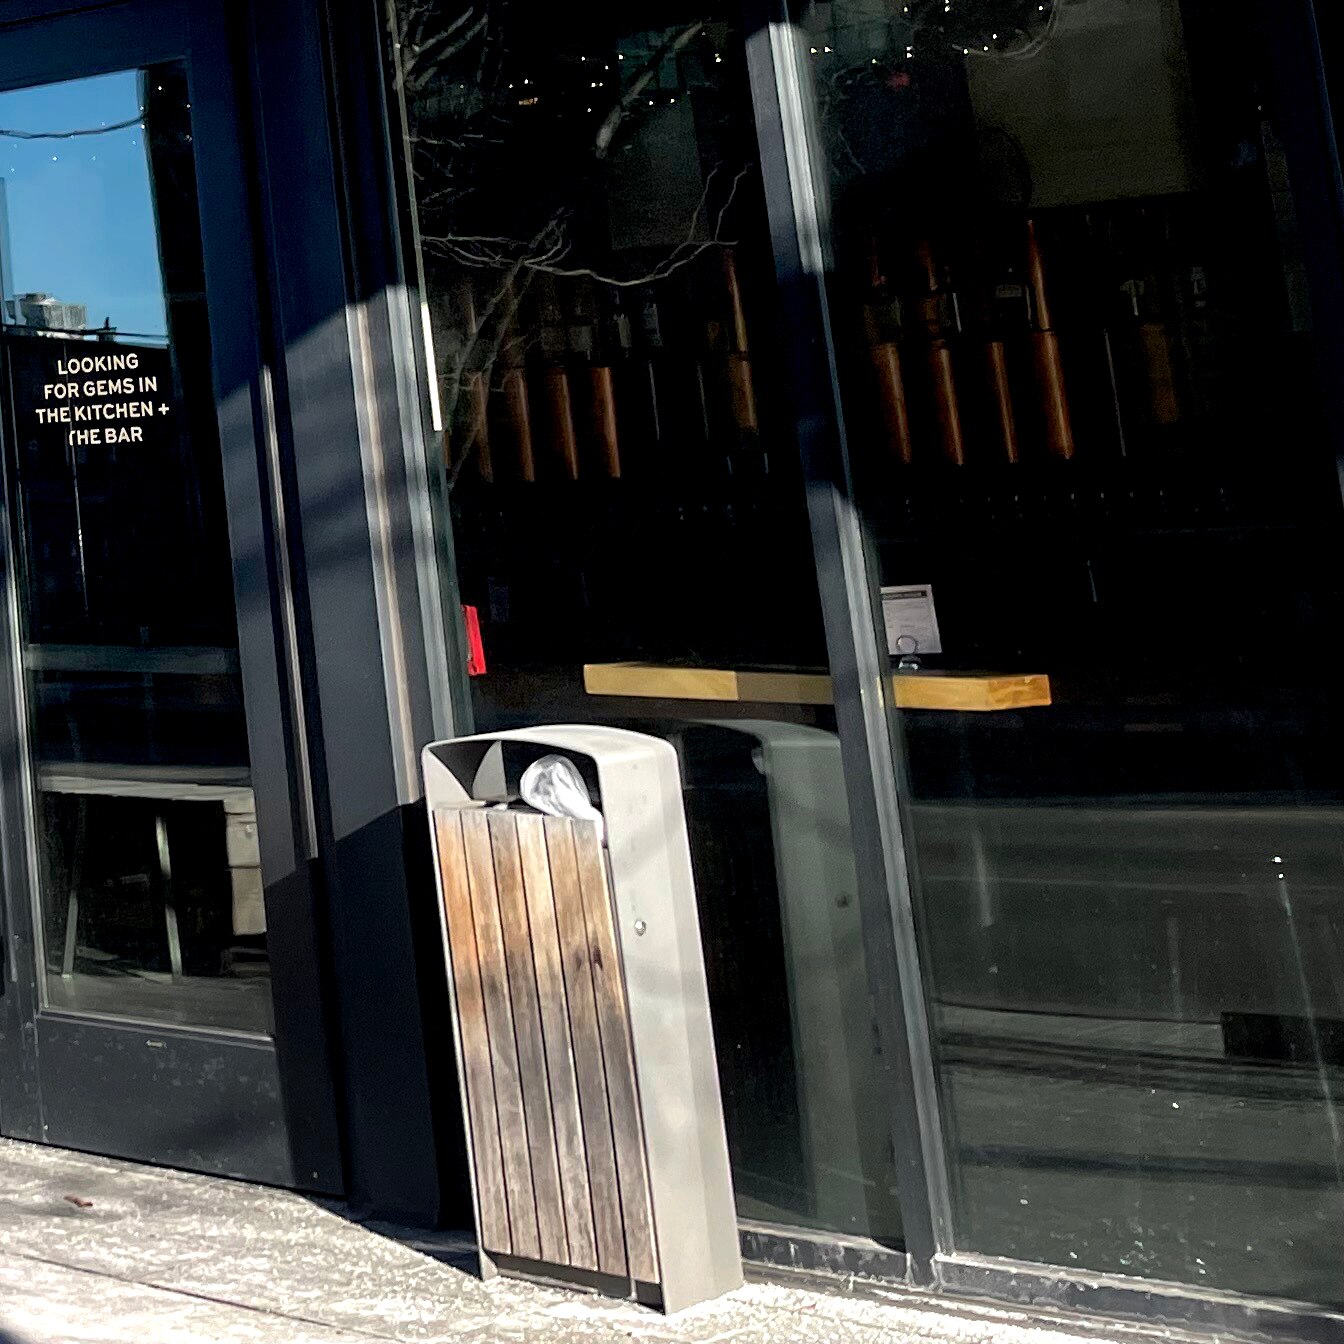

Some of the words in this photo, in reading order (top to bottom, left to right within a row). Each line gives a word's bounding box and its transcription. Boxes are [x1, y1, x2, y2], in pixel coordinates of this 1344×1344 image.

[57, 352, 139, 375] LOOKING
[44, 382, 80, 400] FOR
[83, 377, 135, 397] GEMS
[138, 375, 158, 393] IN
[35, 406, 72, 424] THE
[74, 400, 154, 422] KITCHEN
[68, 428, 102, 446] THE
[104, 426, 144, 444] BAR
